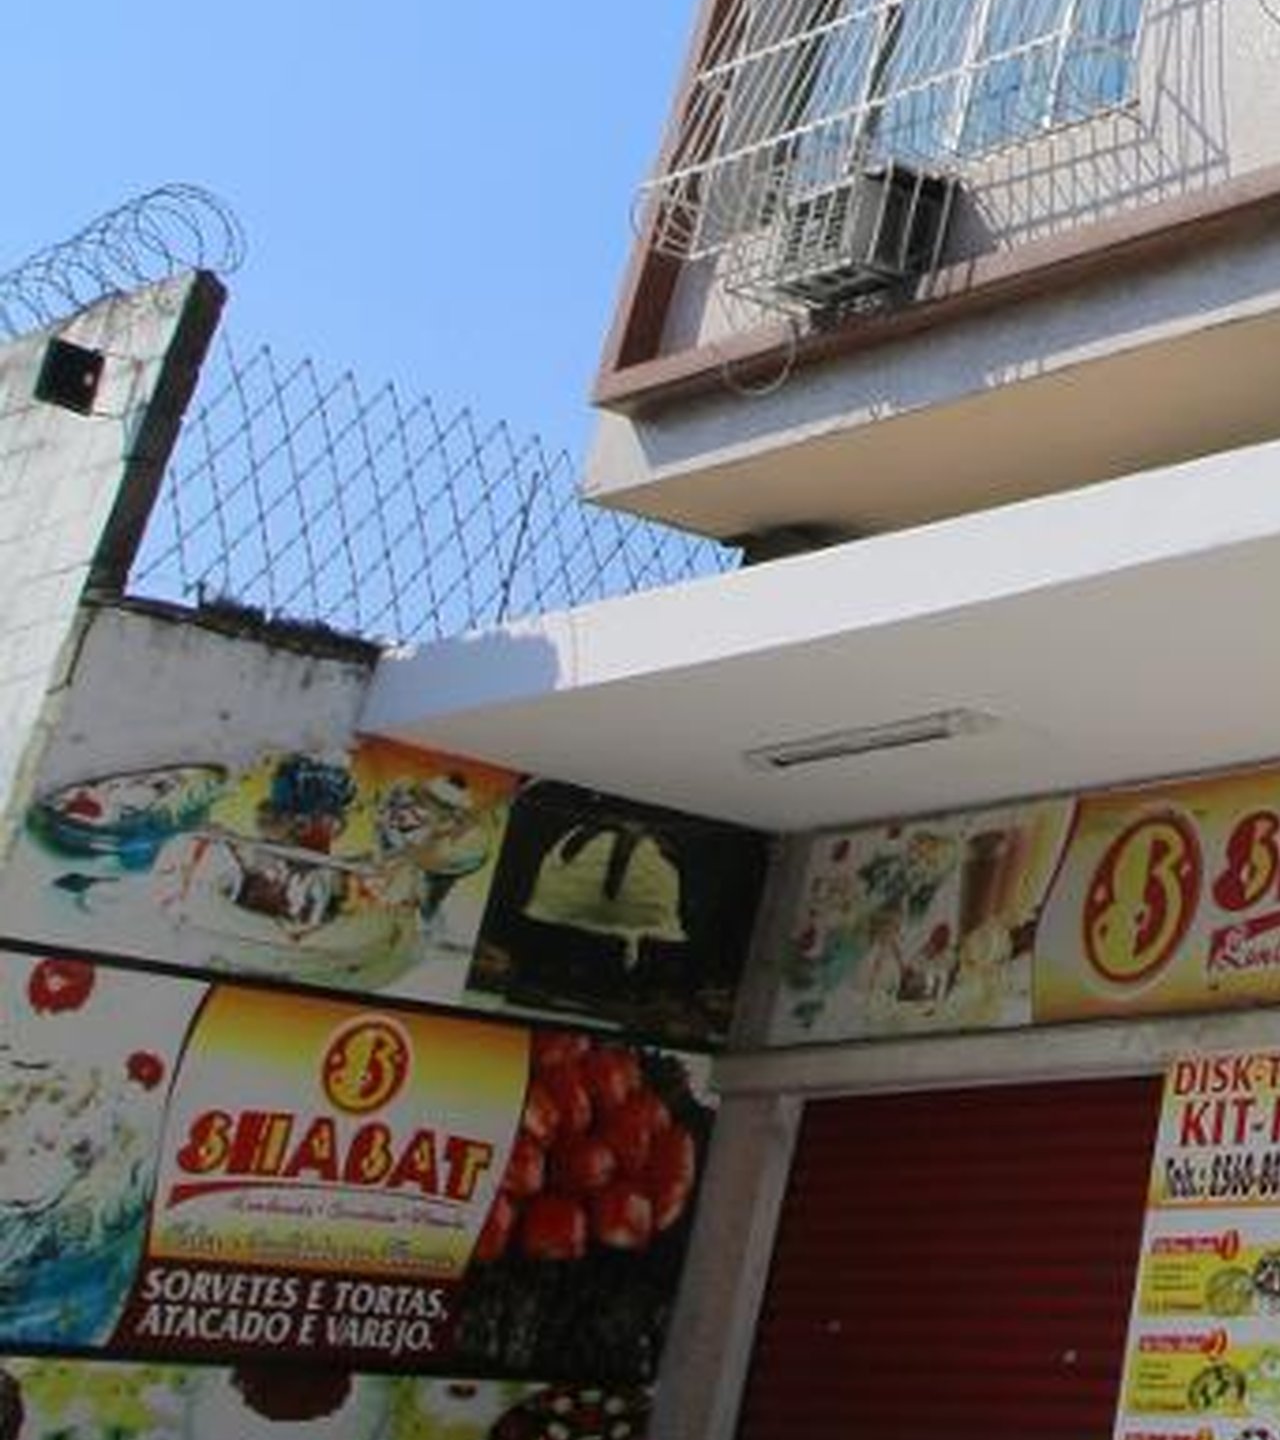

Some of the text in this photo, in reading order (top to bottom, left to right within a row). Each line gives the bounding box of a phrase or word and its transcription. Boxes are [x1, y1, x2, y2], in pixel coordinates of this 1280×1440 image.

[177, 1111, 494, 1203] SHABAT
[141, 1268, 298, 1312] SORVETES
[308, 1281, 330, 1310] E
[136, 1304, 435, 1356] ATACADO E VAREJO.
